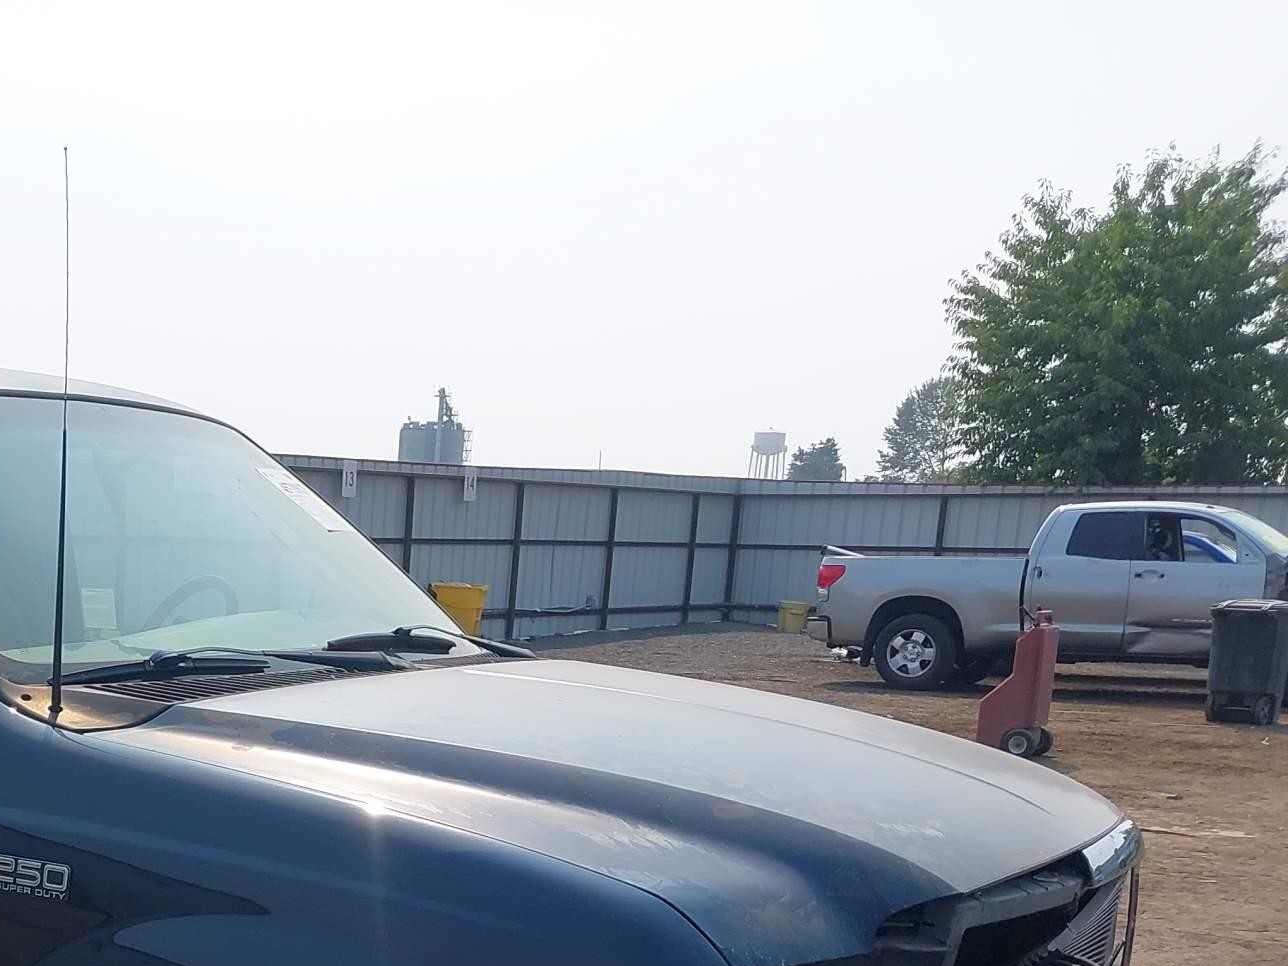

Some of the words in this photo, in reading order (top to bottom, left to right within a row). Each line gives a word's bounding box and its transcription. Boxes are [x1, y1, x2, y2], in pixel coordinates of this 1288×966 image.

[344, 470, 355, 488] 13
[466, 474, 475, 490] 14
[34, 888, 66, 900] DUTY
